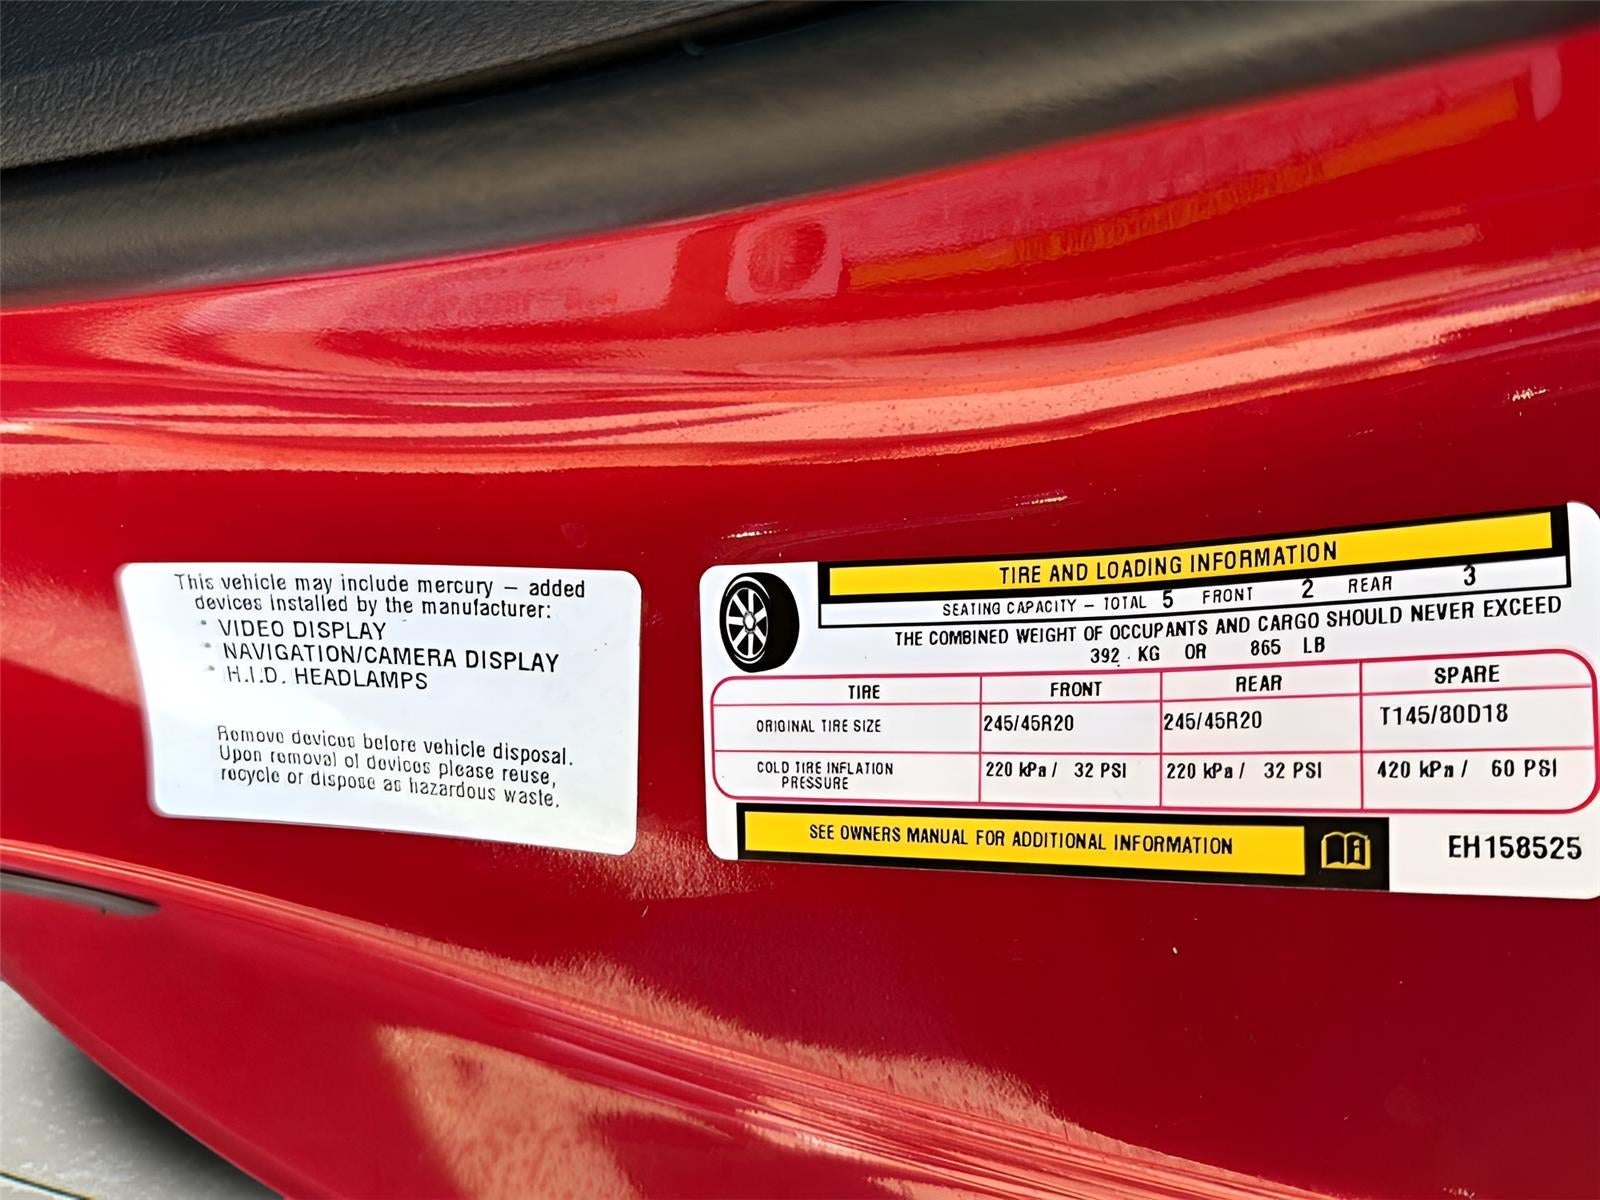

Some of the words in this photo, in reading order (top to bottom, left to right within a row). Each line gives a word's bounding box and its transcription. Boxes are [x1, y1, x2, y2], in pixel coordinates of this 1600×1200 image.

[1000, 566, 1041, 583] TIRE
[1050, 563, 1088, 581] AND
[1097, 555, 1182, 578] LOADING
[1190, 541, 1338, 573] INFORMATION
[174, 572, 214, 591] This
[221, 573, 287, 592] vehicle
[295, 576, 333, 597] may
[341, 573, 409, 594] include
[417, 579, 493, 598] mercury
[529, 579, 586, 598] added
[943, 602, 1001, 617] SEATING
[1007, 599, 1075, 614] CAPACITY
[1104, 596, 1147, 610] TOTAL
[1162, 590, 1174, 608] 5
[1202, 587, 1253, 604] FRONT
[1302, 579, 1314, 598] 2
[1348, 576, 1392, 594] REAR
[1463, 564, 1476, 585] 3
[194, 593, 263, 611] devices
[270, 594, 349, 613] installed
[356, 595, 378, 616] by
[385, 596, 414, 614] the
[421, 597, 552, 619] manufacturer:
[217, 619, 285, 638] VIDEO
[293, 621, 386, 641] DISPLAY
[895, 631, 923, 646] THE
[929, 627, 1009, 645] COMBINED
[1016, 626, 1078, 643] WEIGHT
[1084, 626, 1103, 641] OF
[1109, 621, 1209, 641] OCCUPANTS
[1215, 618, 1250, 634] AND
[1258, 613, 1319, 632] CARGO
[1326, 606, 1402, 627] SHOULD
[1411, 600, 1474, 622] NEVER
[1483, 596, 1562, 617] EXCEED
[223, 642, 457, 669] NAVIGATION/CAMERA
[465, 650, 560, 673] DISPLAY
[1090, 648, 1120, 664] 392
[1138, 646, 1160, 662] KG
[1184, 644, 1207, 659] OR
[1250, 640, 1281, 656] 865
[1303, 637, 1325, 653] LB
[227, 665, 287, 685] H.I.D.
[295, 668, 428, 690] HEADLAMPS
[1235, 675, 1282, 692] REAR
[1434, 665, 1500, 684] SPARE
[848, 685, 881, 700] TIRE
[1050, 682, 1102, 697] FRONT
[756, 719, 815, 733] ORIGINAL
[821, 719, 849, 733] TIRE
[853, 719, 881, 733] SIZE
[983, 715, 1074, 732] 245/45R20
[1163, 712, 1262, 731] 245/45R20
[1380, 704, 1508, 726] T145/80D18
[423, 737, 486, 758] vehicle
[492, 742, 574, 766] disposal.
[219, 744, 263, 764] Upon
[439, 760, 495, 780] please
[502, 767, 557, 789] reuse,
[756, 761, 790, 775] COLD
[795, 761, 823, 775] TIRE
[827, 761, 893, 775] INFLATION
[986, 762, 1013, 778] 220
[1075, 762, 1095, 778] 32
[1100, 762, 1127, 778] PSI
[1166, 763, 1196, 779] 220
[1264, 762, 1287, 779] 32
[1293, 762, 1323, 779] PSI
[1378, 761, 1411, 779] 420
[1492, 760, 1515, 777] 60
[1524, 759, 1557, 778] PSI
[287, 771, 303, 786] or
[409, 776, 497, 801] hazardous
[504, 784, 560, 809] waste.
[782, 776, 849, 790] PRESSURE
[809, 824, 835, 839] SEE
[841, 826, 901, 843] OWNERS
[906, 827, 968, 845] MANUAL
[976, 830, 1006, 846] FOR
[1012, 831, 1105, 850] ADDITIONAL
[1114, 834, 1233, 855] INFORMATION
[1448, 834, 1582, 860] EH158525
